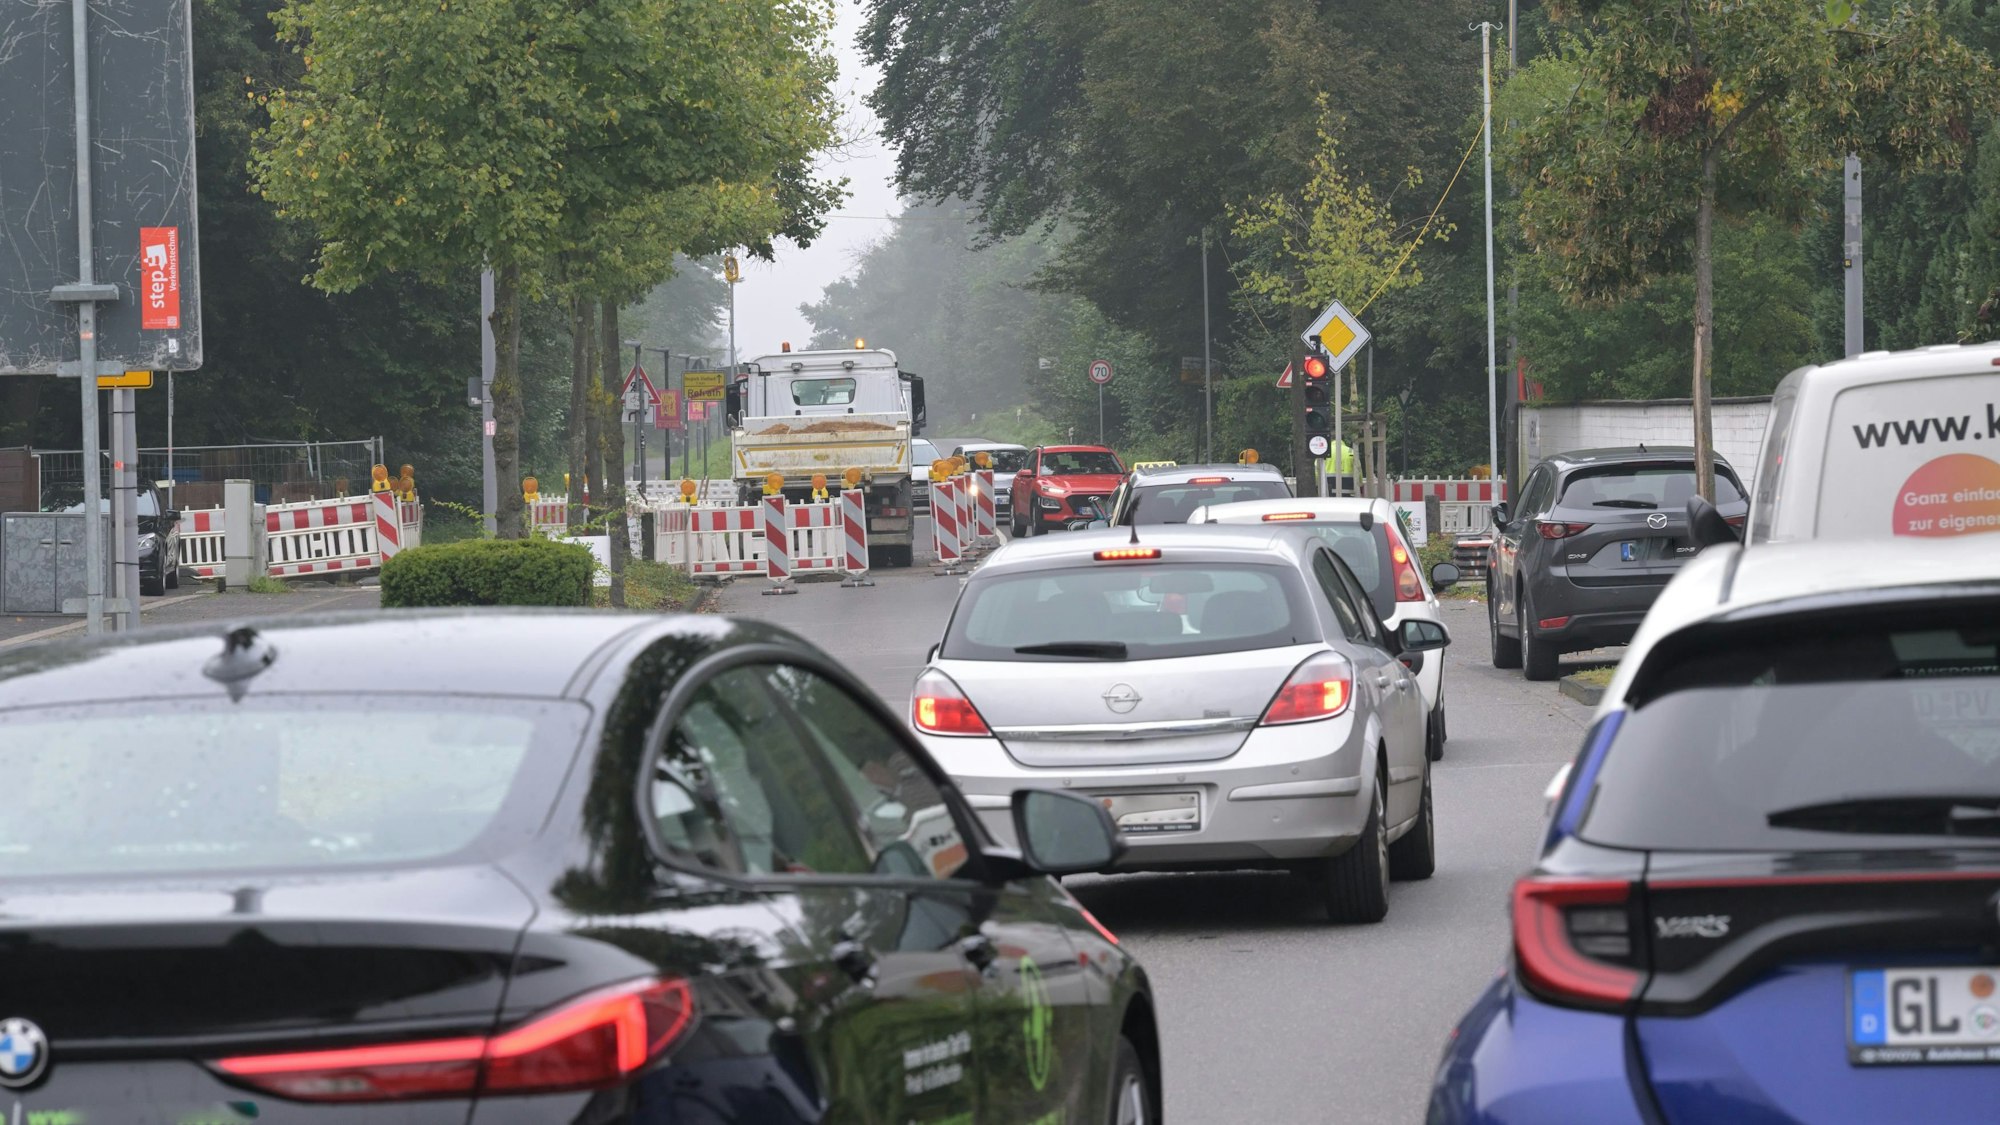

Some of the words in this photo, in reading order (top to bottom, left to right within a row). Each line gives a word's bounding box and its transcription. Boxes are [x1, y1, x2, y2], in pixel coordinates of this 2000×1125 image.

[168, 229, 177, 292] Verkehrstechnik
[150, 270, 168, 308] step
[1094, 366, 1108, 377] 70
[1903, 492, 1948, 506] Ganz
[1908, 519, 1934, 531] zur
[1891, 977, 1960, 1035] GL
